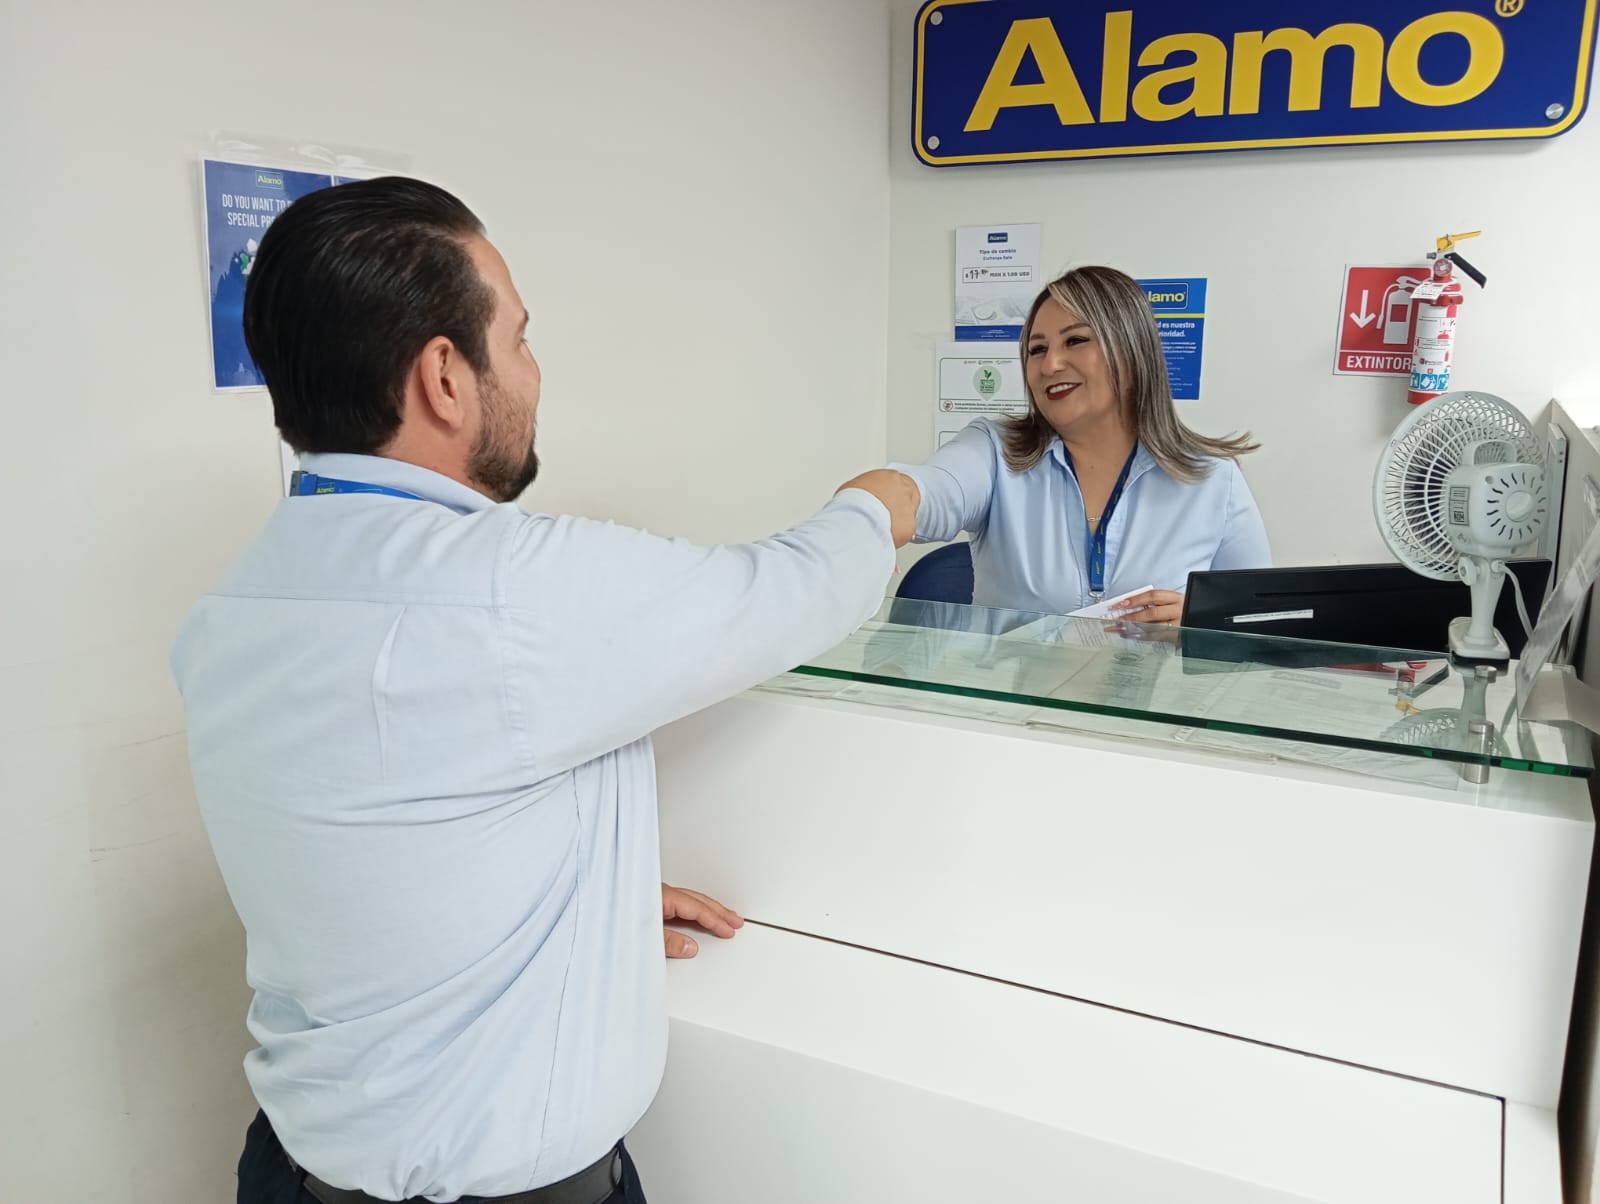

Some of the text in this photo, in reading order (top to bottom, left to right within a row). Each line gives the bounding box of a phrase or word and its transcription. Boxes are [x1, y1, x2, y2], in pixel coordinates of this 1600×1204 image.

[963, 10, 1505, 133] Alamo
[257, 175, 281, 185] Alamo
[221, 193, 233, 208] DO
[234, 194, 250, 210] YOU
[251, 196, 274, 212] WANT
[275, 199, 286, 213] TO
[227, 212, 260, 228] SPECIAL
[1148, 291, 1185, 302] lamo
[1158, 329, 1186, 337] rioridad.
[1346, 355, 1411, 370] EXTINTOR
